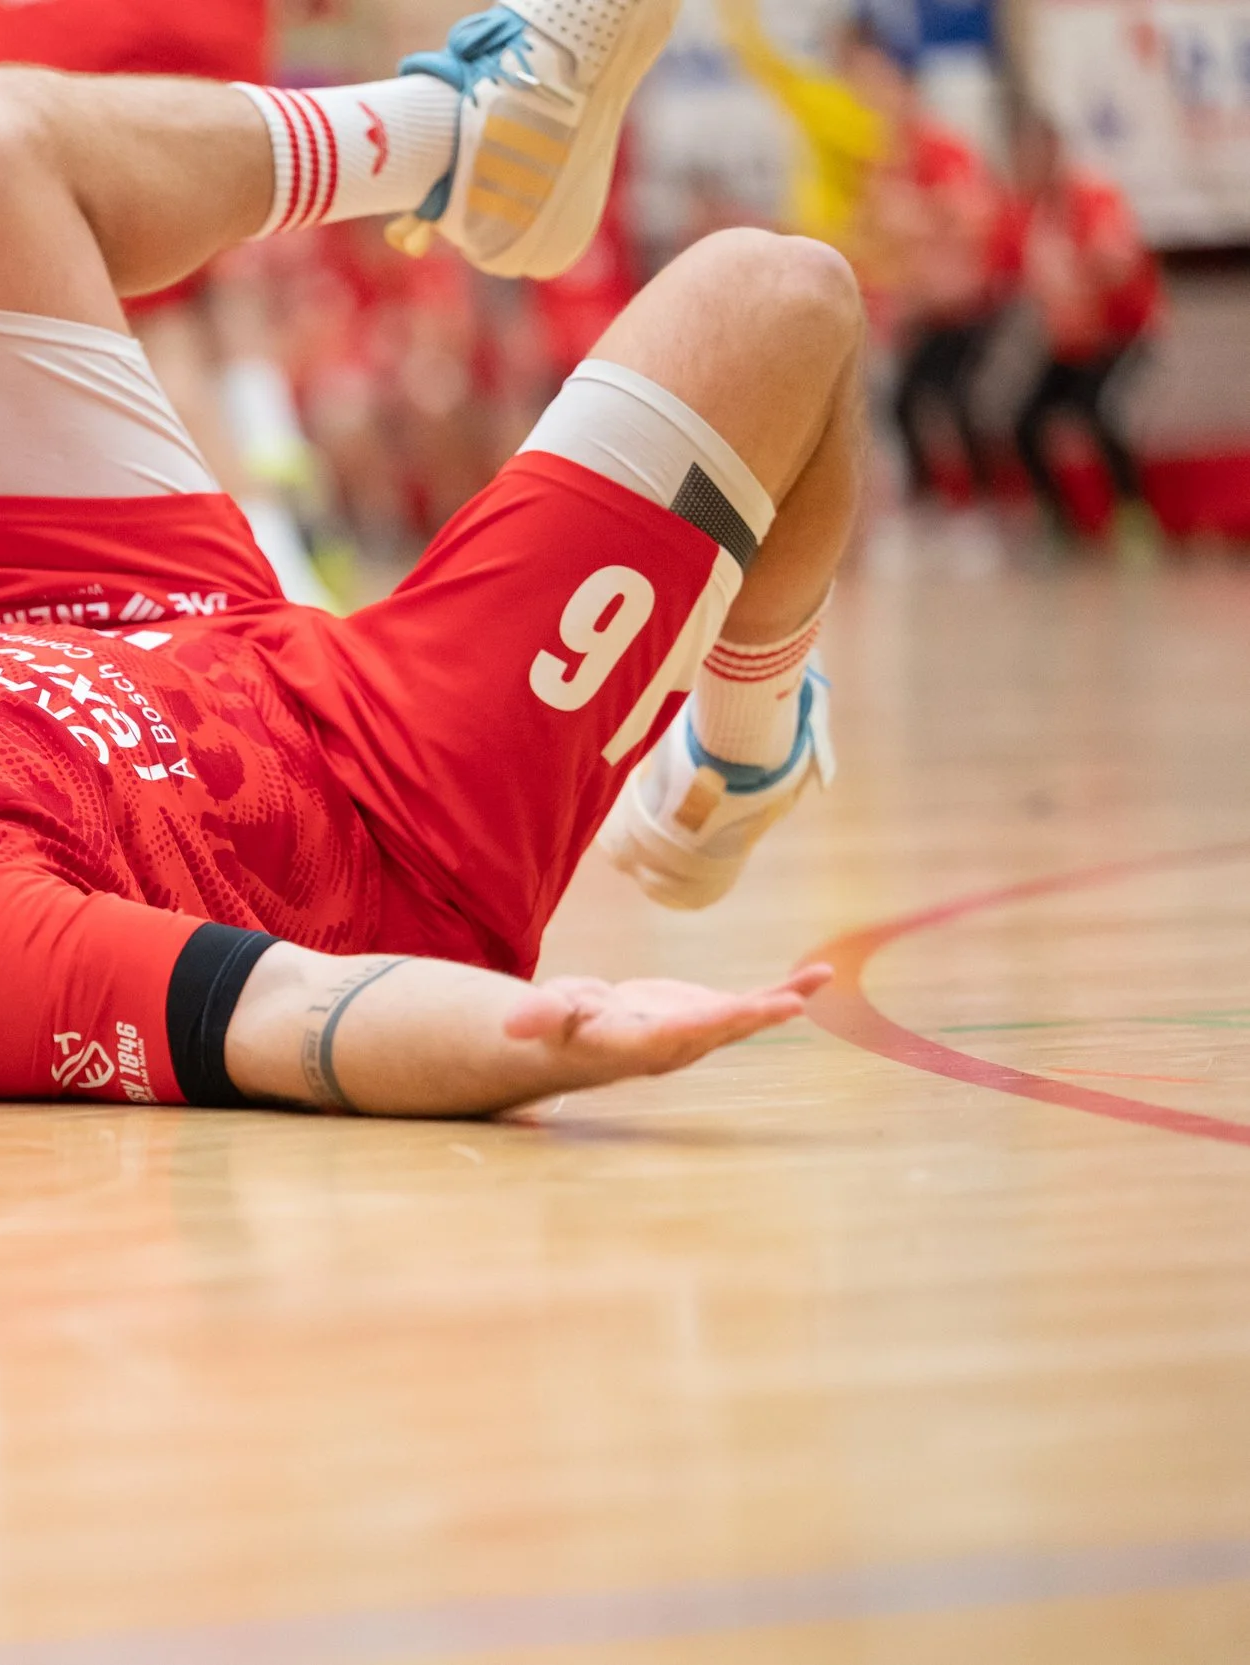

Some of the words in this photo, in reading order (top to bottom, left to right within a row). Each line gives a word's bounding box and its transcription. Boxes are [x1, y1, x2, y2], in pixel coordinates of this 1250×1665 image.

[98, 663, 177, 744] Bosch
[168, 757, 197, 779] A
[115, 1020, 141, 1078] 1846
